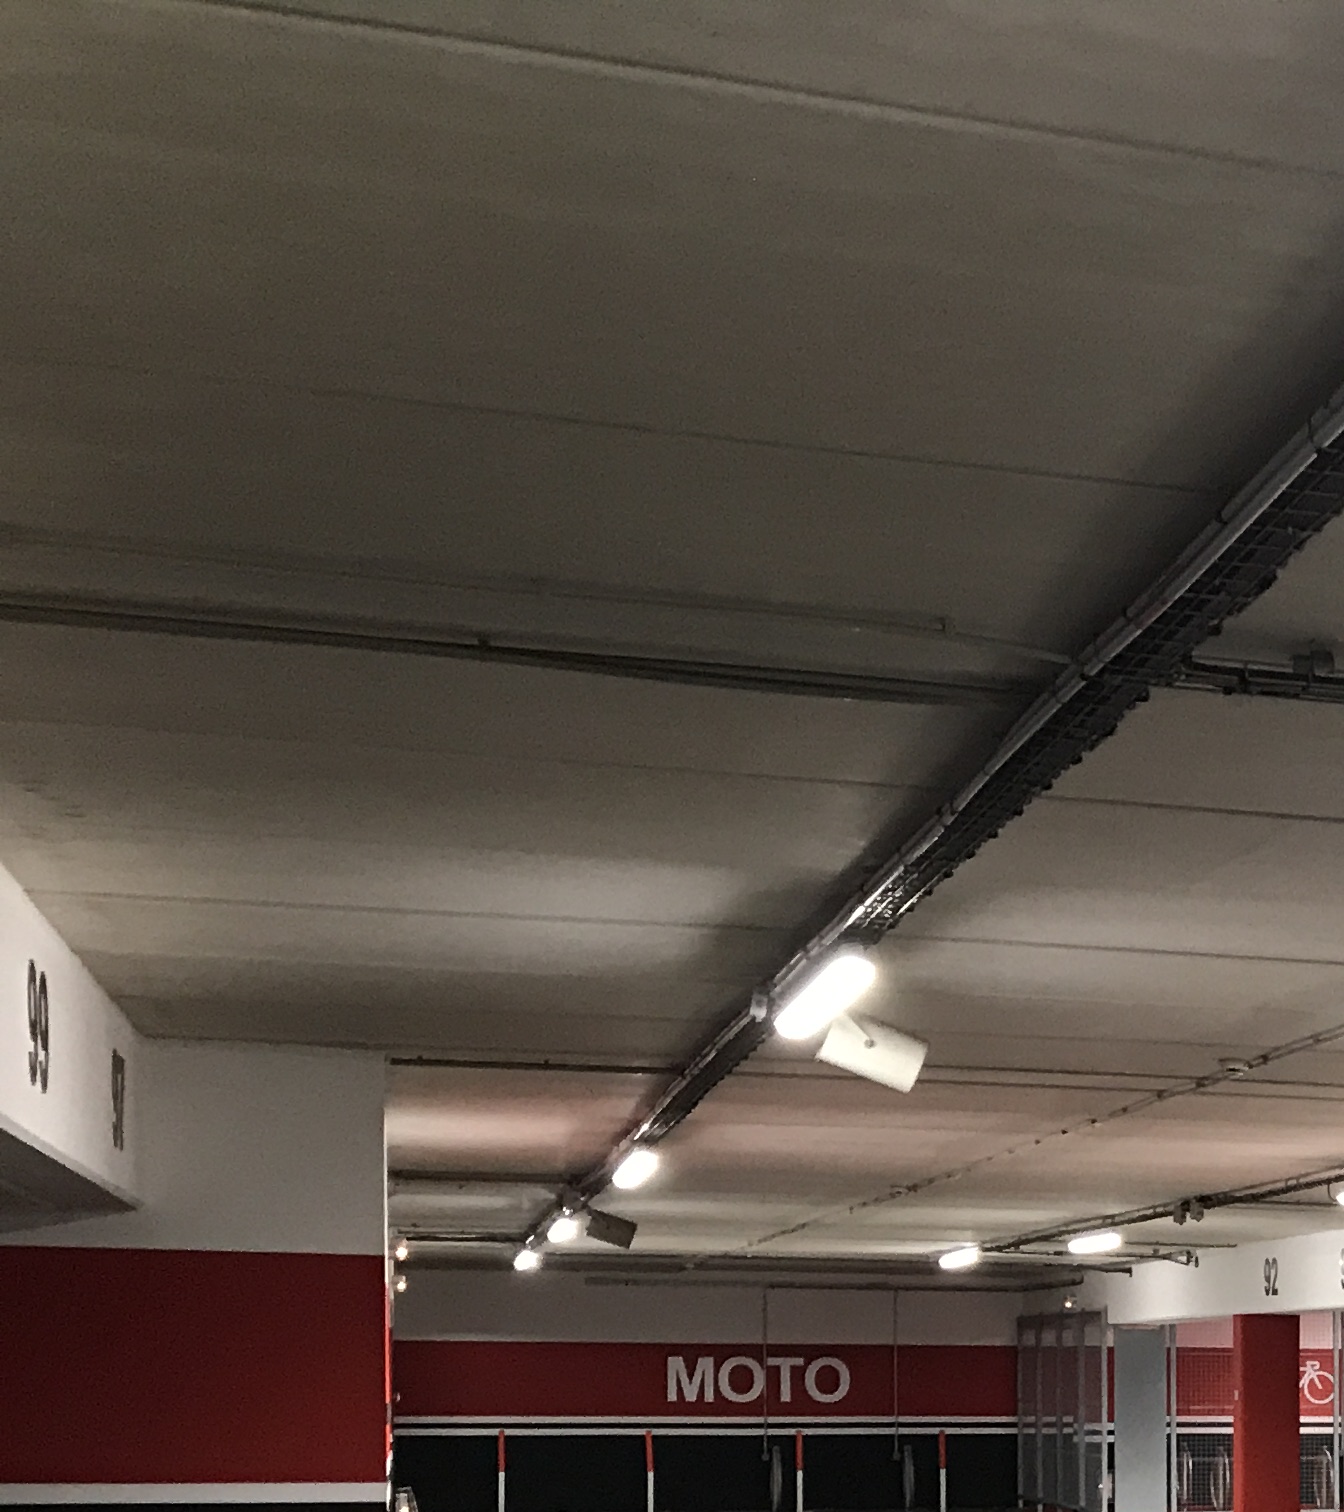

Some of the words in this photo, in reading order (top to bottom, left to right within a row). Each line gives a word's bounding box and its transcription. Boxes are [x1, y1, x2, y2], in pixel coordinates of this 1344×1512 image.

[27, 959, 49, 1094] 99
[1263, 1257, 1278, 1296] 92
[667, 1356, 851, 1403] MOTO
